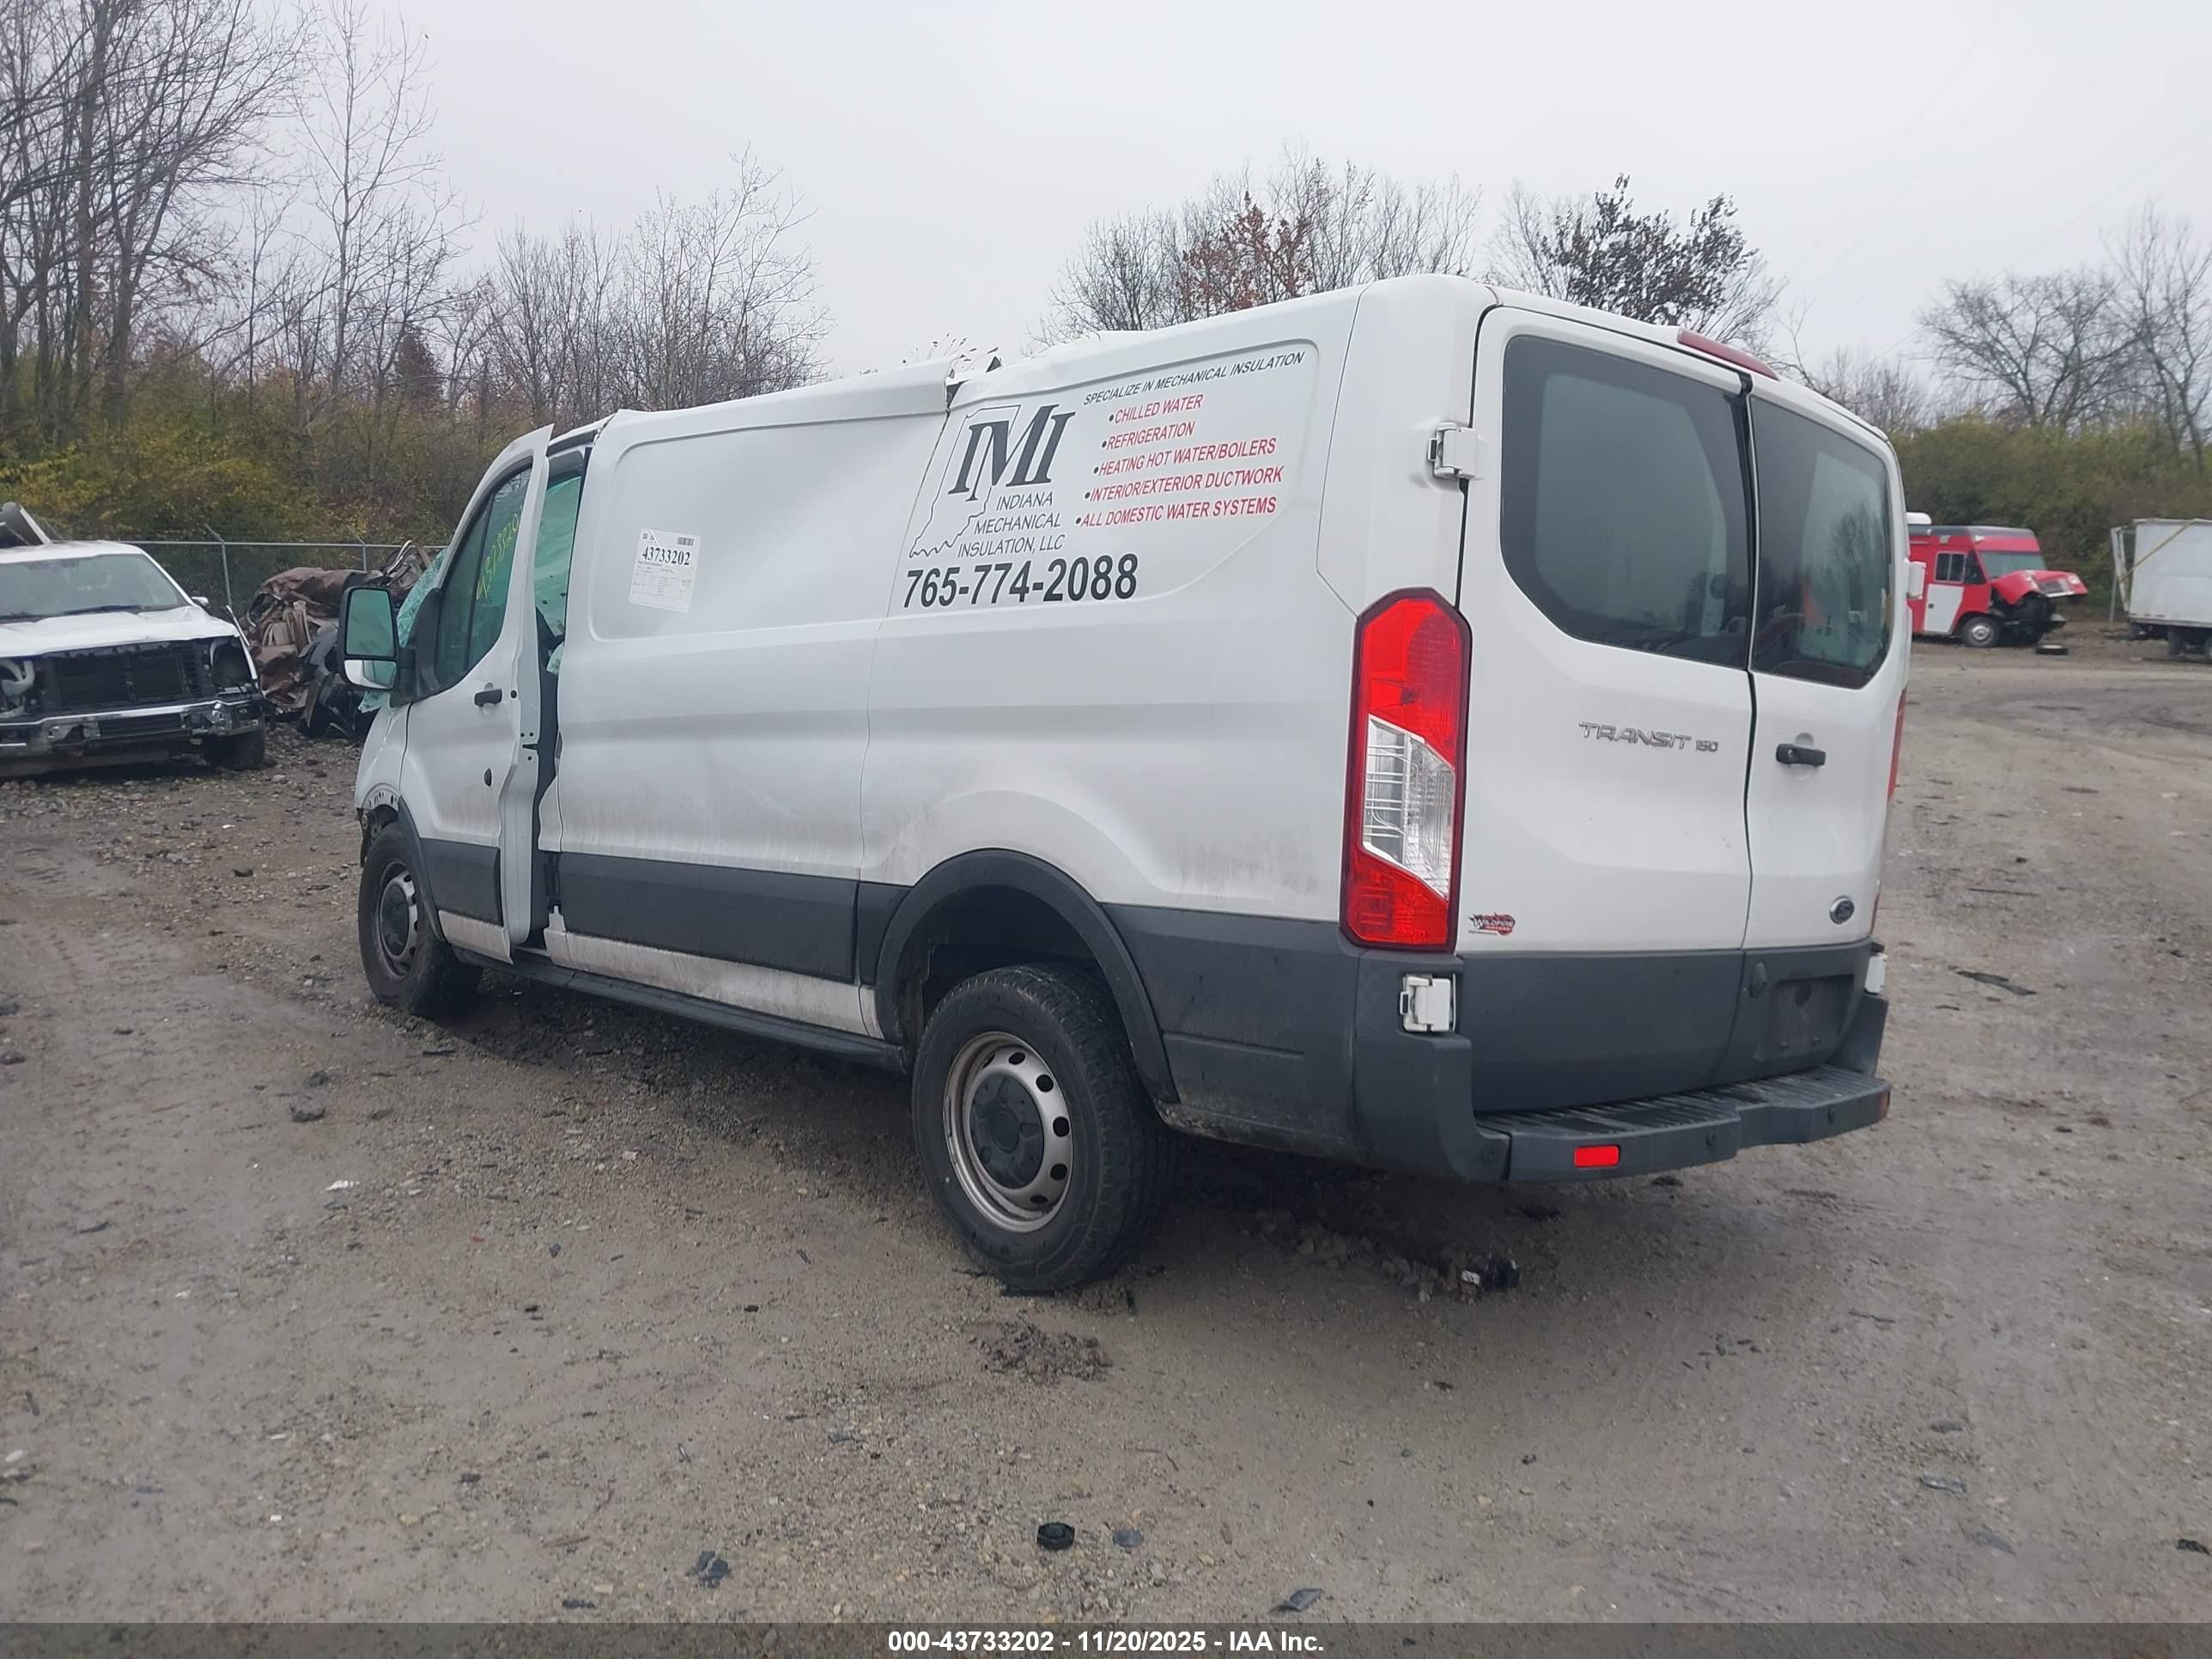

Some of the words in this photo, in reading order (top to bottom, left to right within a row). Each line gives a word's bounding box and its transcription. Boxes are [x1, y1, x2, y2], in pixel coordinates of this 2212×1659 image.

[1084, 383, 1141, 406] SPECIALIZE
[1141, 379, 1154, 393] IN
[1154, 365, 1227, 390] MECHANICAL
[1230, 350, 1306, 376] INSULATION
[1115, 402, 1161, 424] CHILLED
[1162, 394, 1204, 415] WATER
[1106, 421, 1196, 450] REFRIGERATION
[1098, 454, 1146, 477] HEATING
[1146, 450, 1172, 469] HOT
[1173, 437, 1277, 465] WATER/BOILERS
[1090, 474, 1203, 502] INTERIOR/EXTERIOR
[1205, 466, 1285, 489] DUCTWORK
[996, 491, 1053, 512] INDIANA
[1080, 513, 1103, 528] ALL
[1104, 505, 1164, 526] DOMESTIC
[1166, 501, 1210, 520] WATER
[1212, 496, 1277, 516] SYSTEMS
[974, 513, 1061, 535] MECHANICAL
[642, 546, 691, 566] 43733202
[957, 536, 1036, 558] INSULATION,
[1038, 534, 1066, 551] LLC
[903, 553, 1139, 608] 765-774-2088
[1579, 721, 1692, 750] TRANSIT
